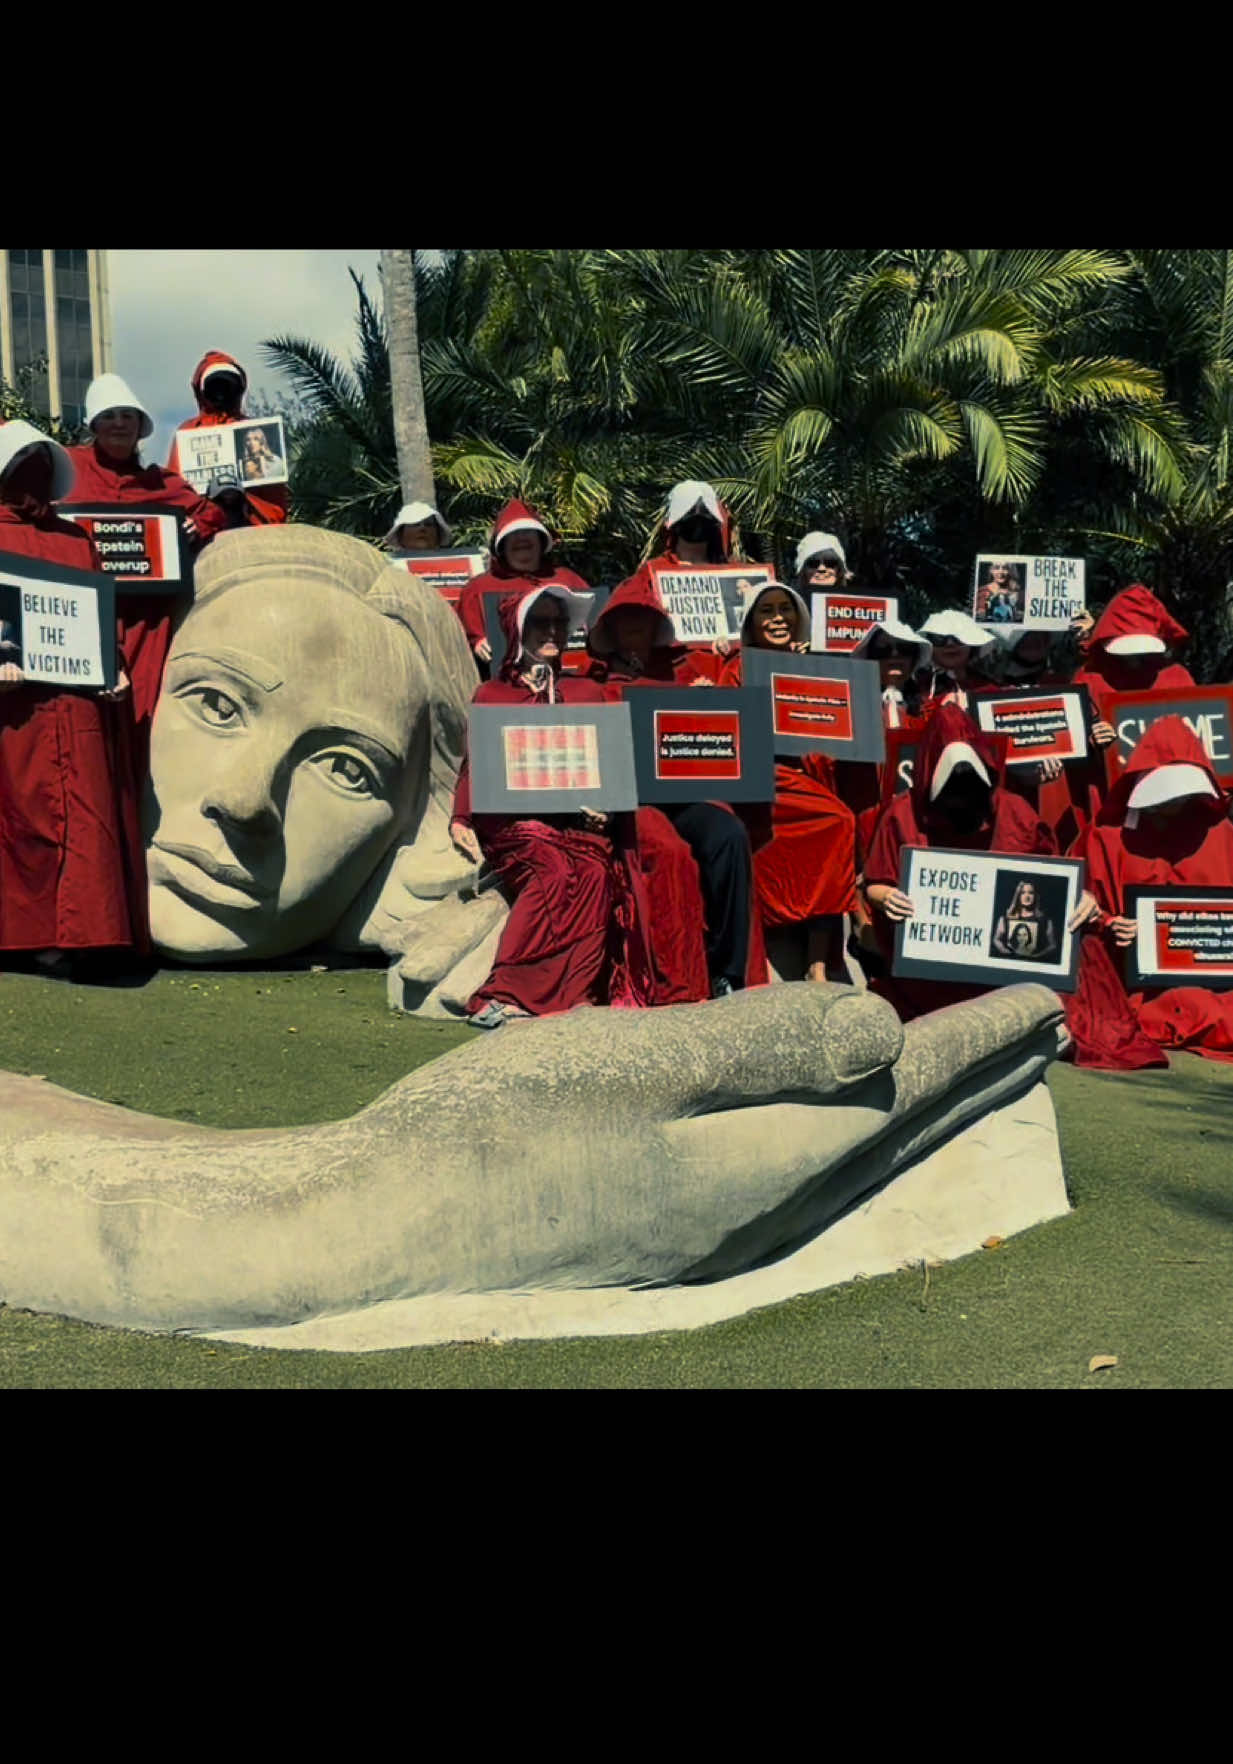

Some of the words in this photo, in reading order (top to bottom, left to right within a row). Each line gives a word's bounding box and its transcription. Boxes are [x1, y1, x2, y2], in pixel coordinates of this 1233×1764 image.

[94, 521, 142, 534] Bondi's
[95, 540, 143, 554] Epstein
[102, 560, 149, 573] overup
[1034, 559, 1077, 579] BREAK
[661, 575, 719, 595] DEMAND
[1044, 579, 1068, 597] THE
[23, 593, 79, 618] BELIEVE
[667, 596, 722, 615] JUSTICE
[828, 606, 852, 619] END
[855, 607, 885, 622] ELITE
[40, 625, 65, 646] THE
[681, 617, 718, 635] NOW
[28, 654, 91, 676] VICTIMS
[919, 868, 978, 892] EXPOSE
[930, 896, 961, 917] THE
[909, 923, 983, 946] NETWORK
[1168, 938, 1220, 946] CONVICTED
